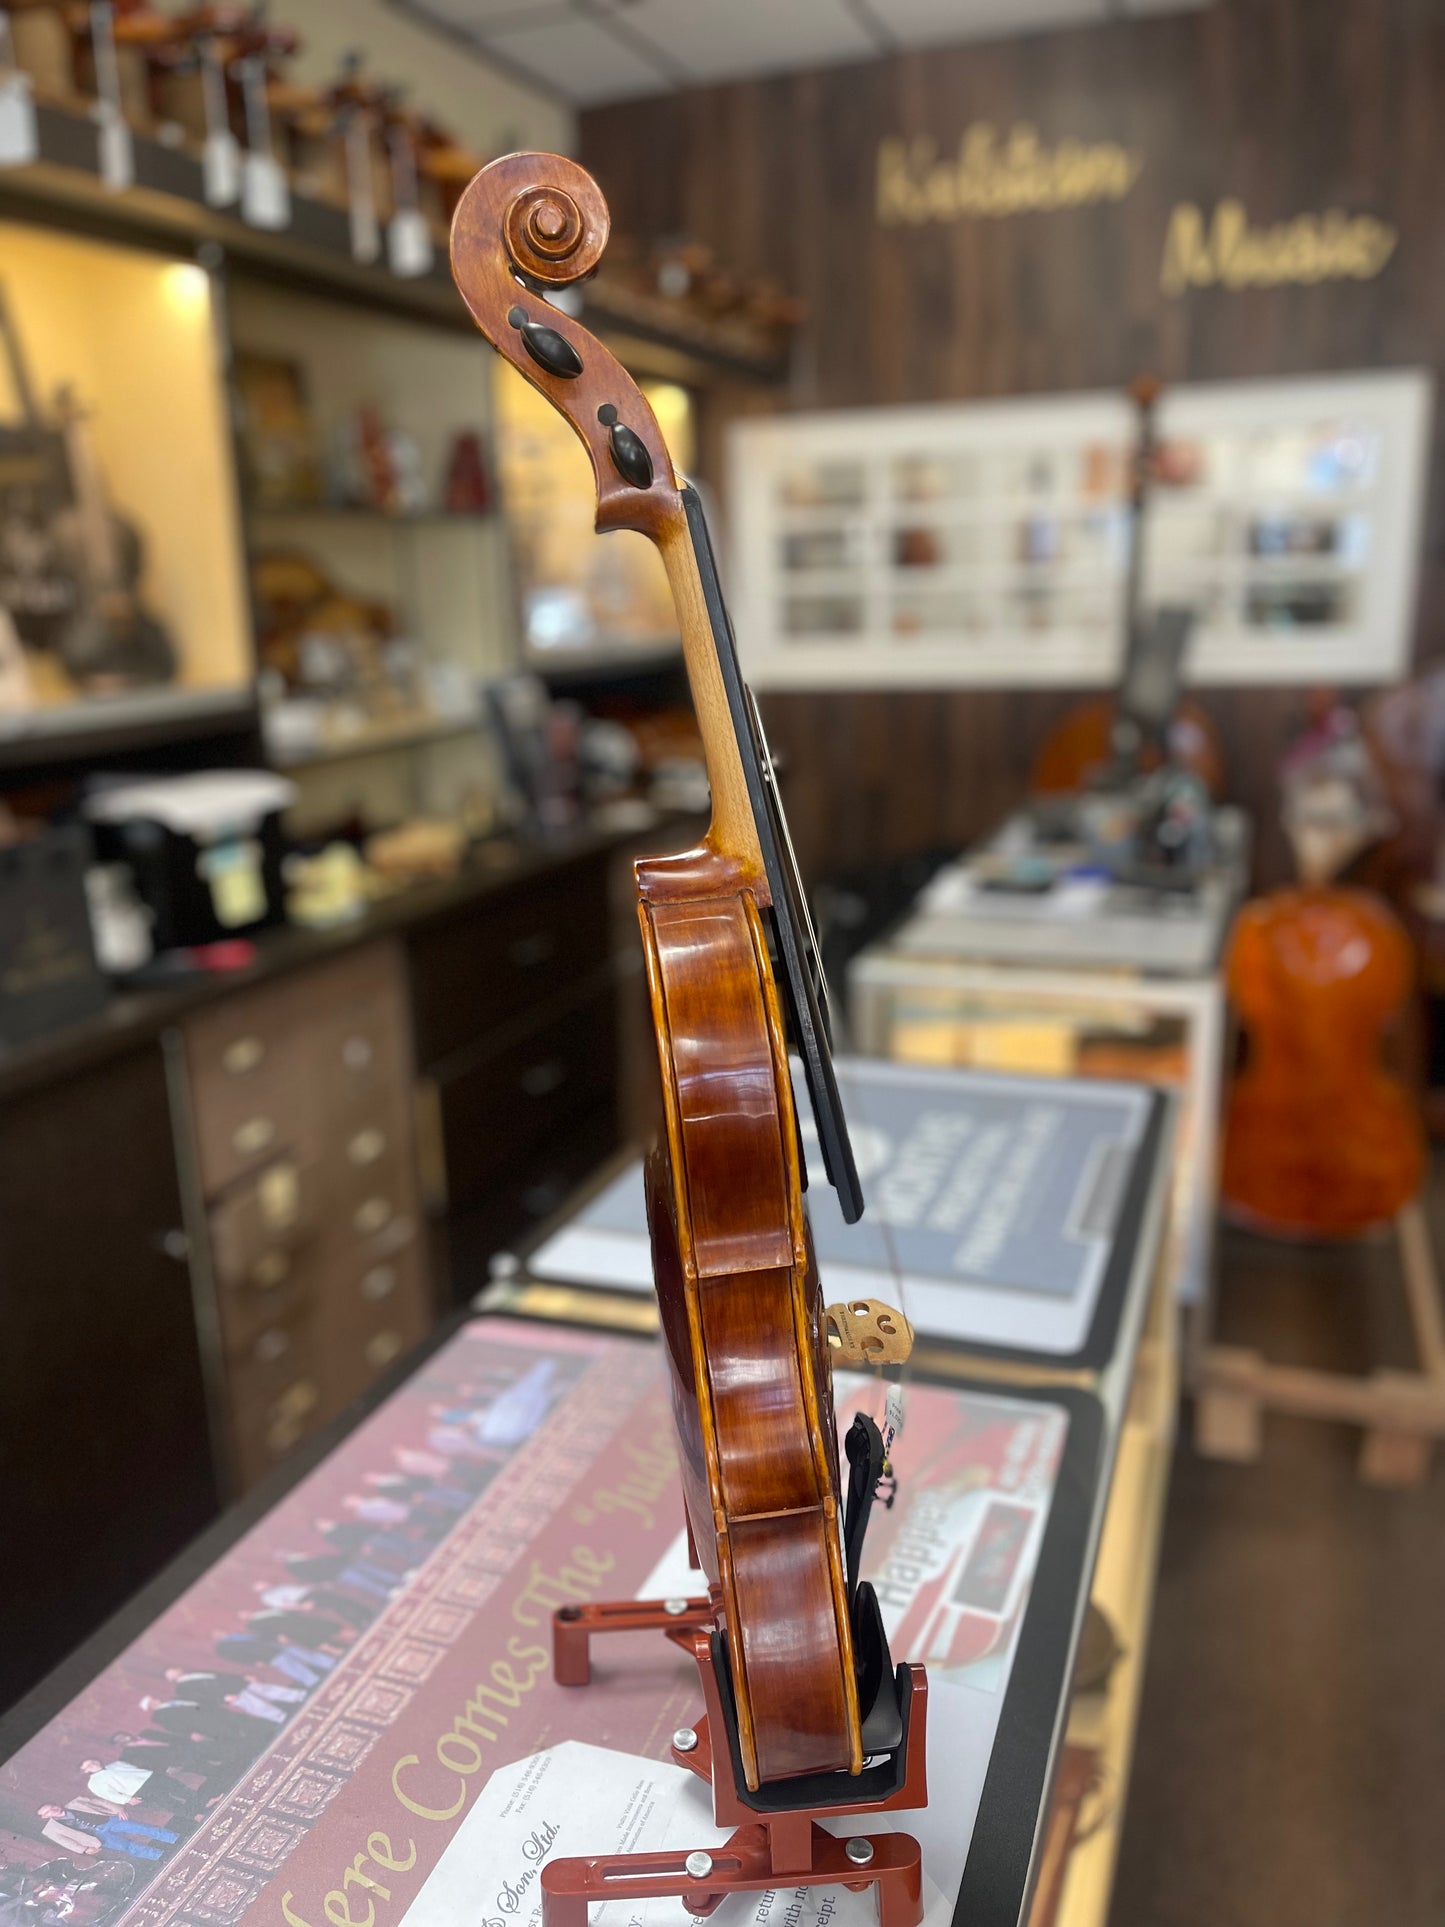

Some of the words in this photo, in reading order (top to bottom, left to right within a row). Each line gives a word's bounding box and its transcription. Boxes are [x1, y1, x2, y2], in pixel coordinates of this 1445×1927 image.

[1161, 198, 1397, 297] Music
[392, 1636, 549, 1821] Comes
[511, 1545, 615, 1627] The
[497, 1870, 538, 1914] Son,
[522, 1820, 561, 1866] Ltd.
